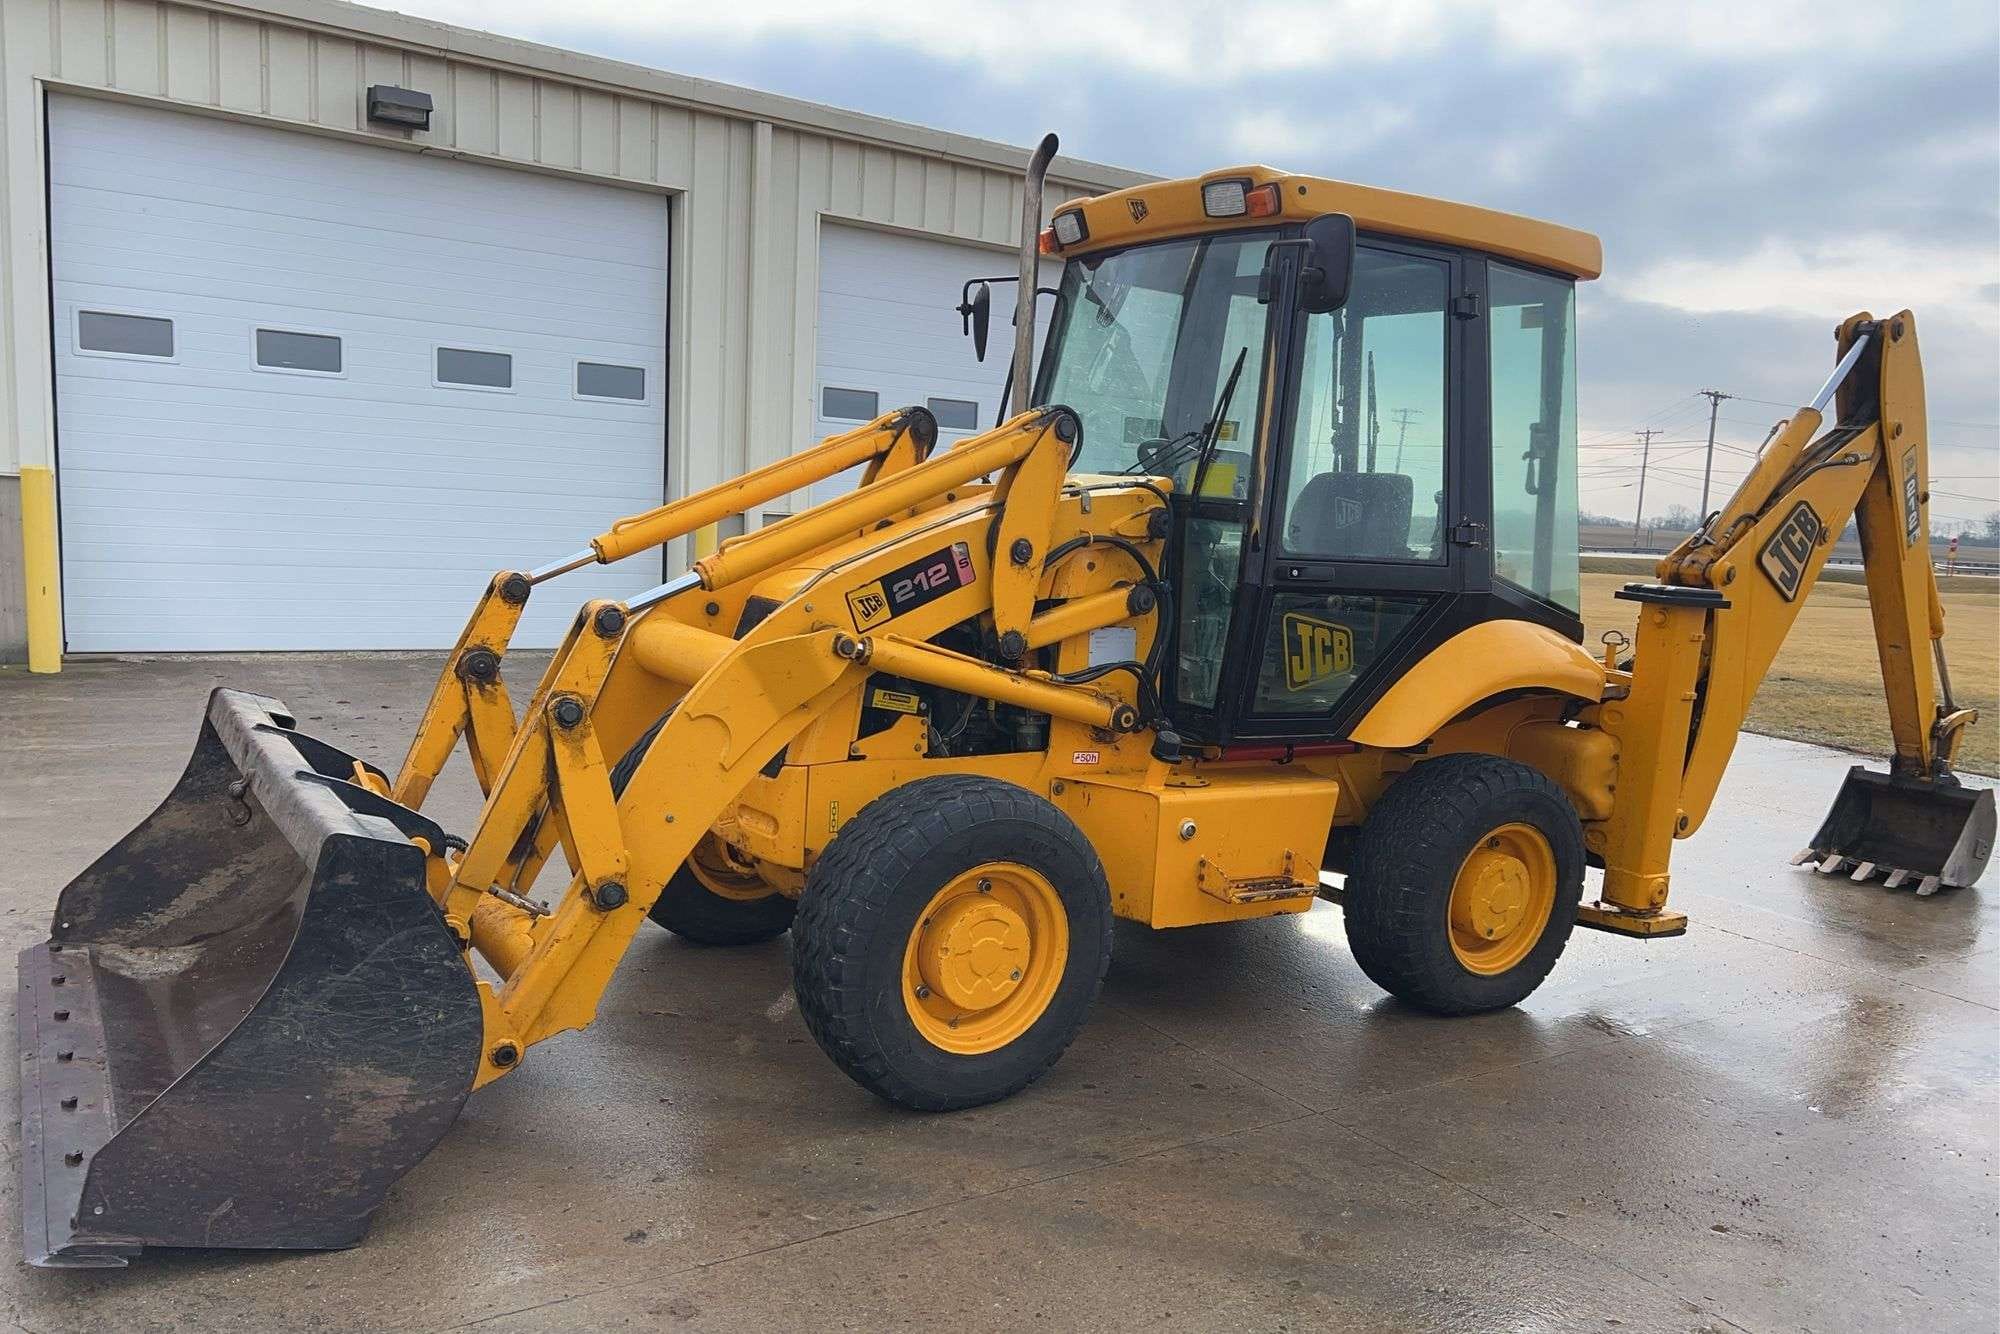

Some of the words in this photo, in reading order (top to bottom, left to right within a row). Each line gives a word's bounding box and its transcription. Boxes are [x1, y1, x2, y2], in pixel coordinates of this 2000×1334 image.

[1768, 508, 1819, 591] JCB
[858, 595, 883, 619] JCB
[892, 562, 951, 603] 212
[1291, 622, 1349, 682] JCB
